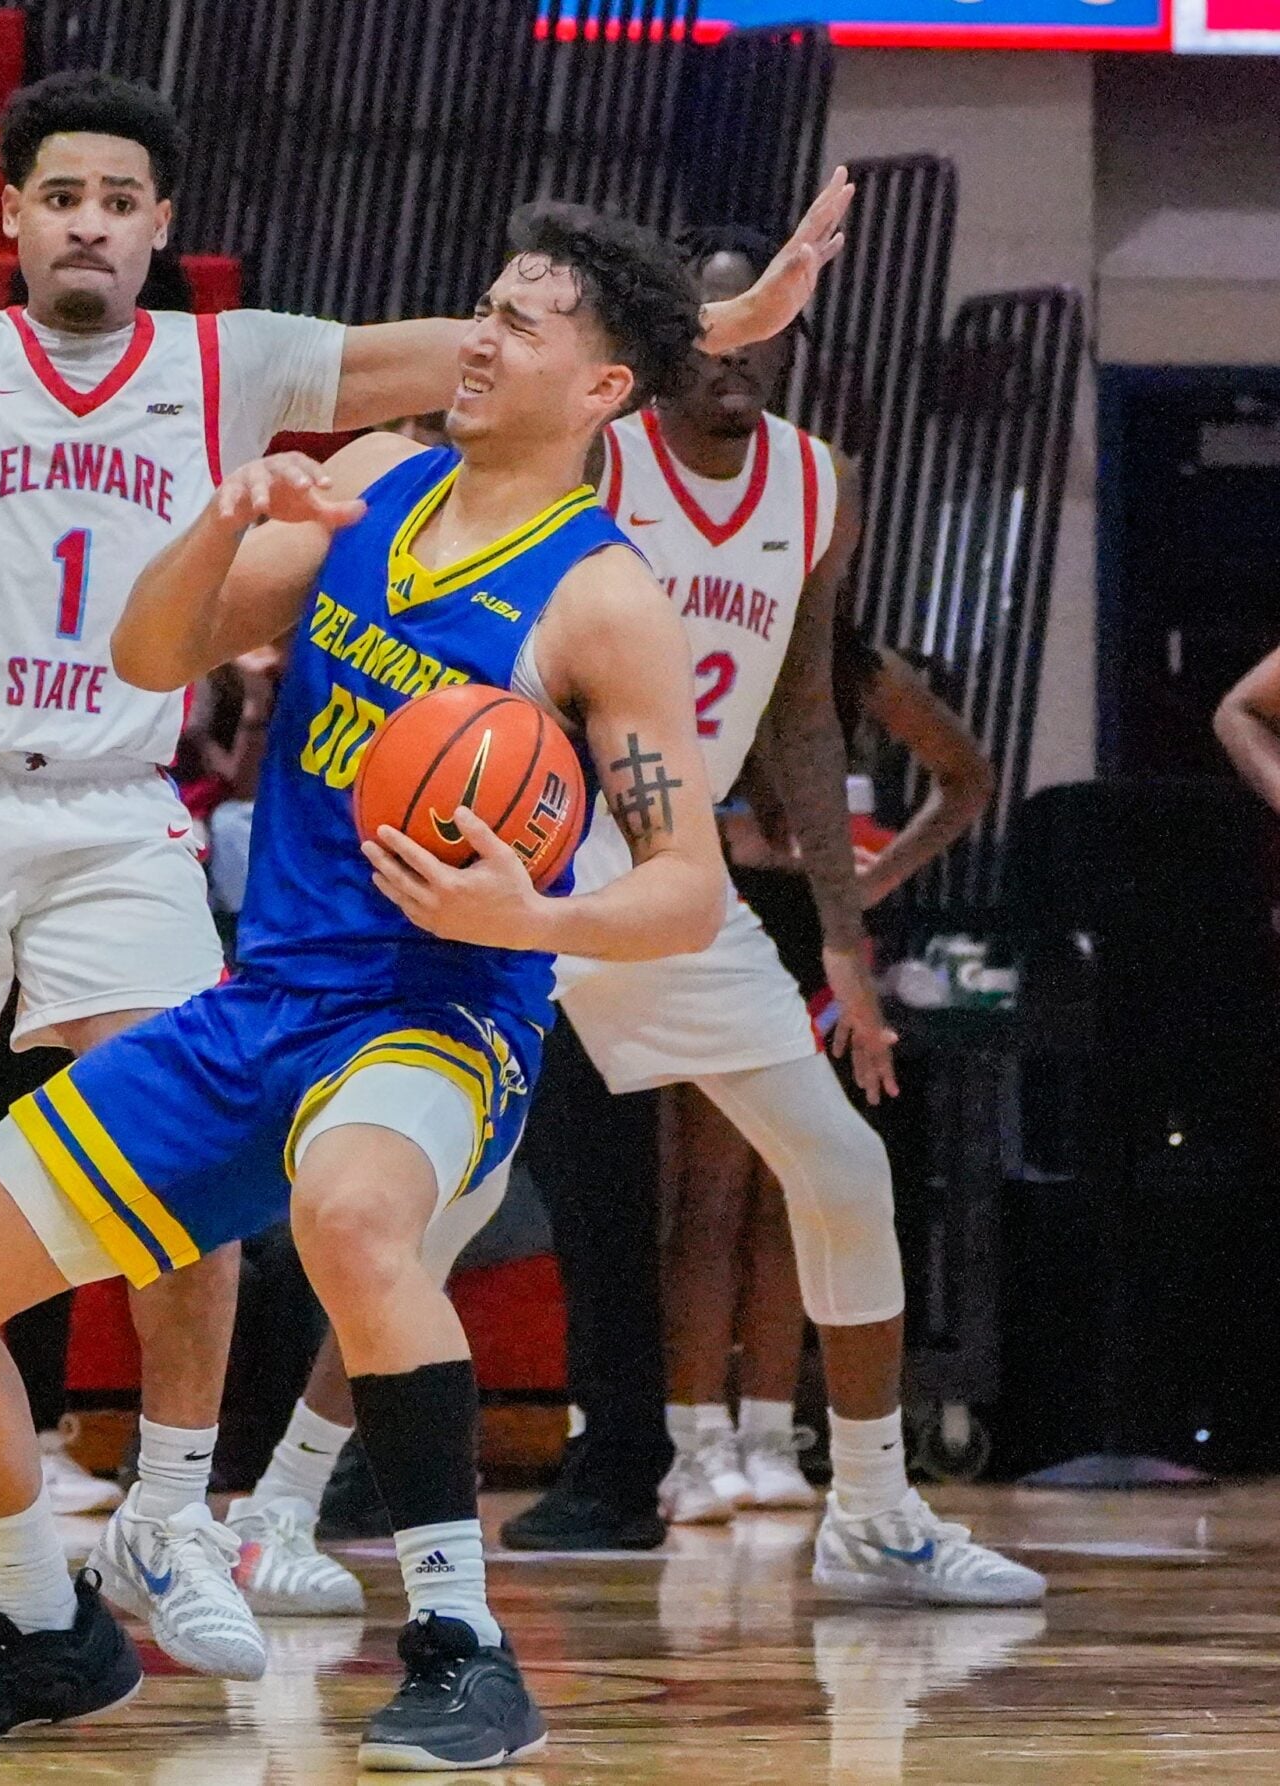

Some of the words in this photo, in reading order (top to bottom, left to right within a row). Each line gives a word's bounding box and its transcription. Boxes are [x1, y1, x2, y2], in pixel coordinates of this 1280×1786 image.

[52, 526, 93, 641] 1
[658, 575, 779, 642] AWARE
[6, 657, 109, 714] STATE
[694, 650, 739, 740] 2
[300, 682, 386, 790] 00
[511, 770, 568, 867] LITE
[415, 1564, 456, 1574] adidas
